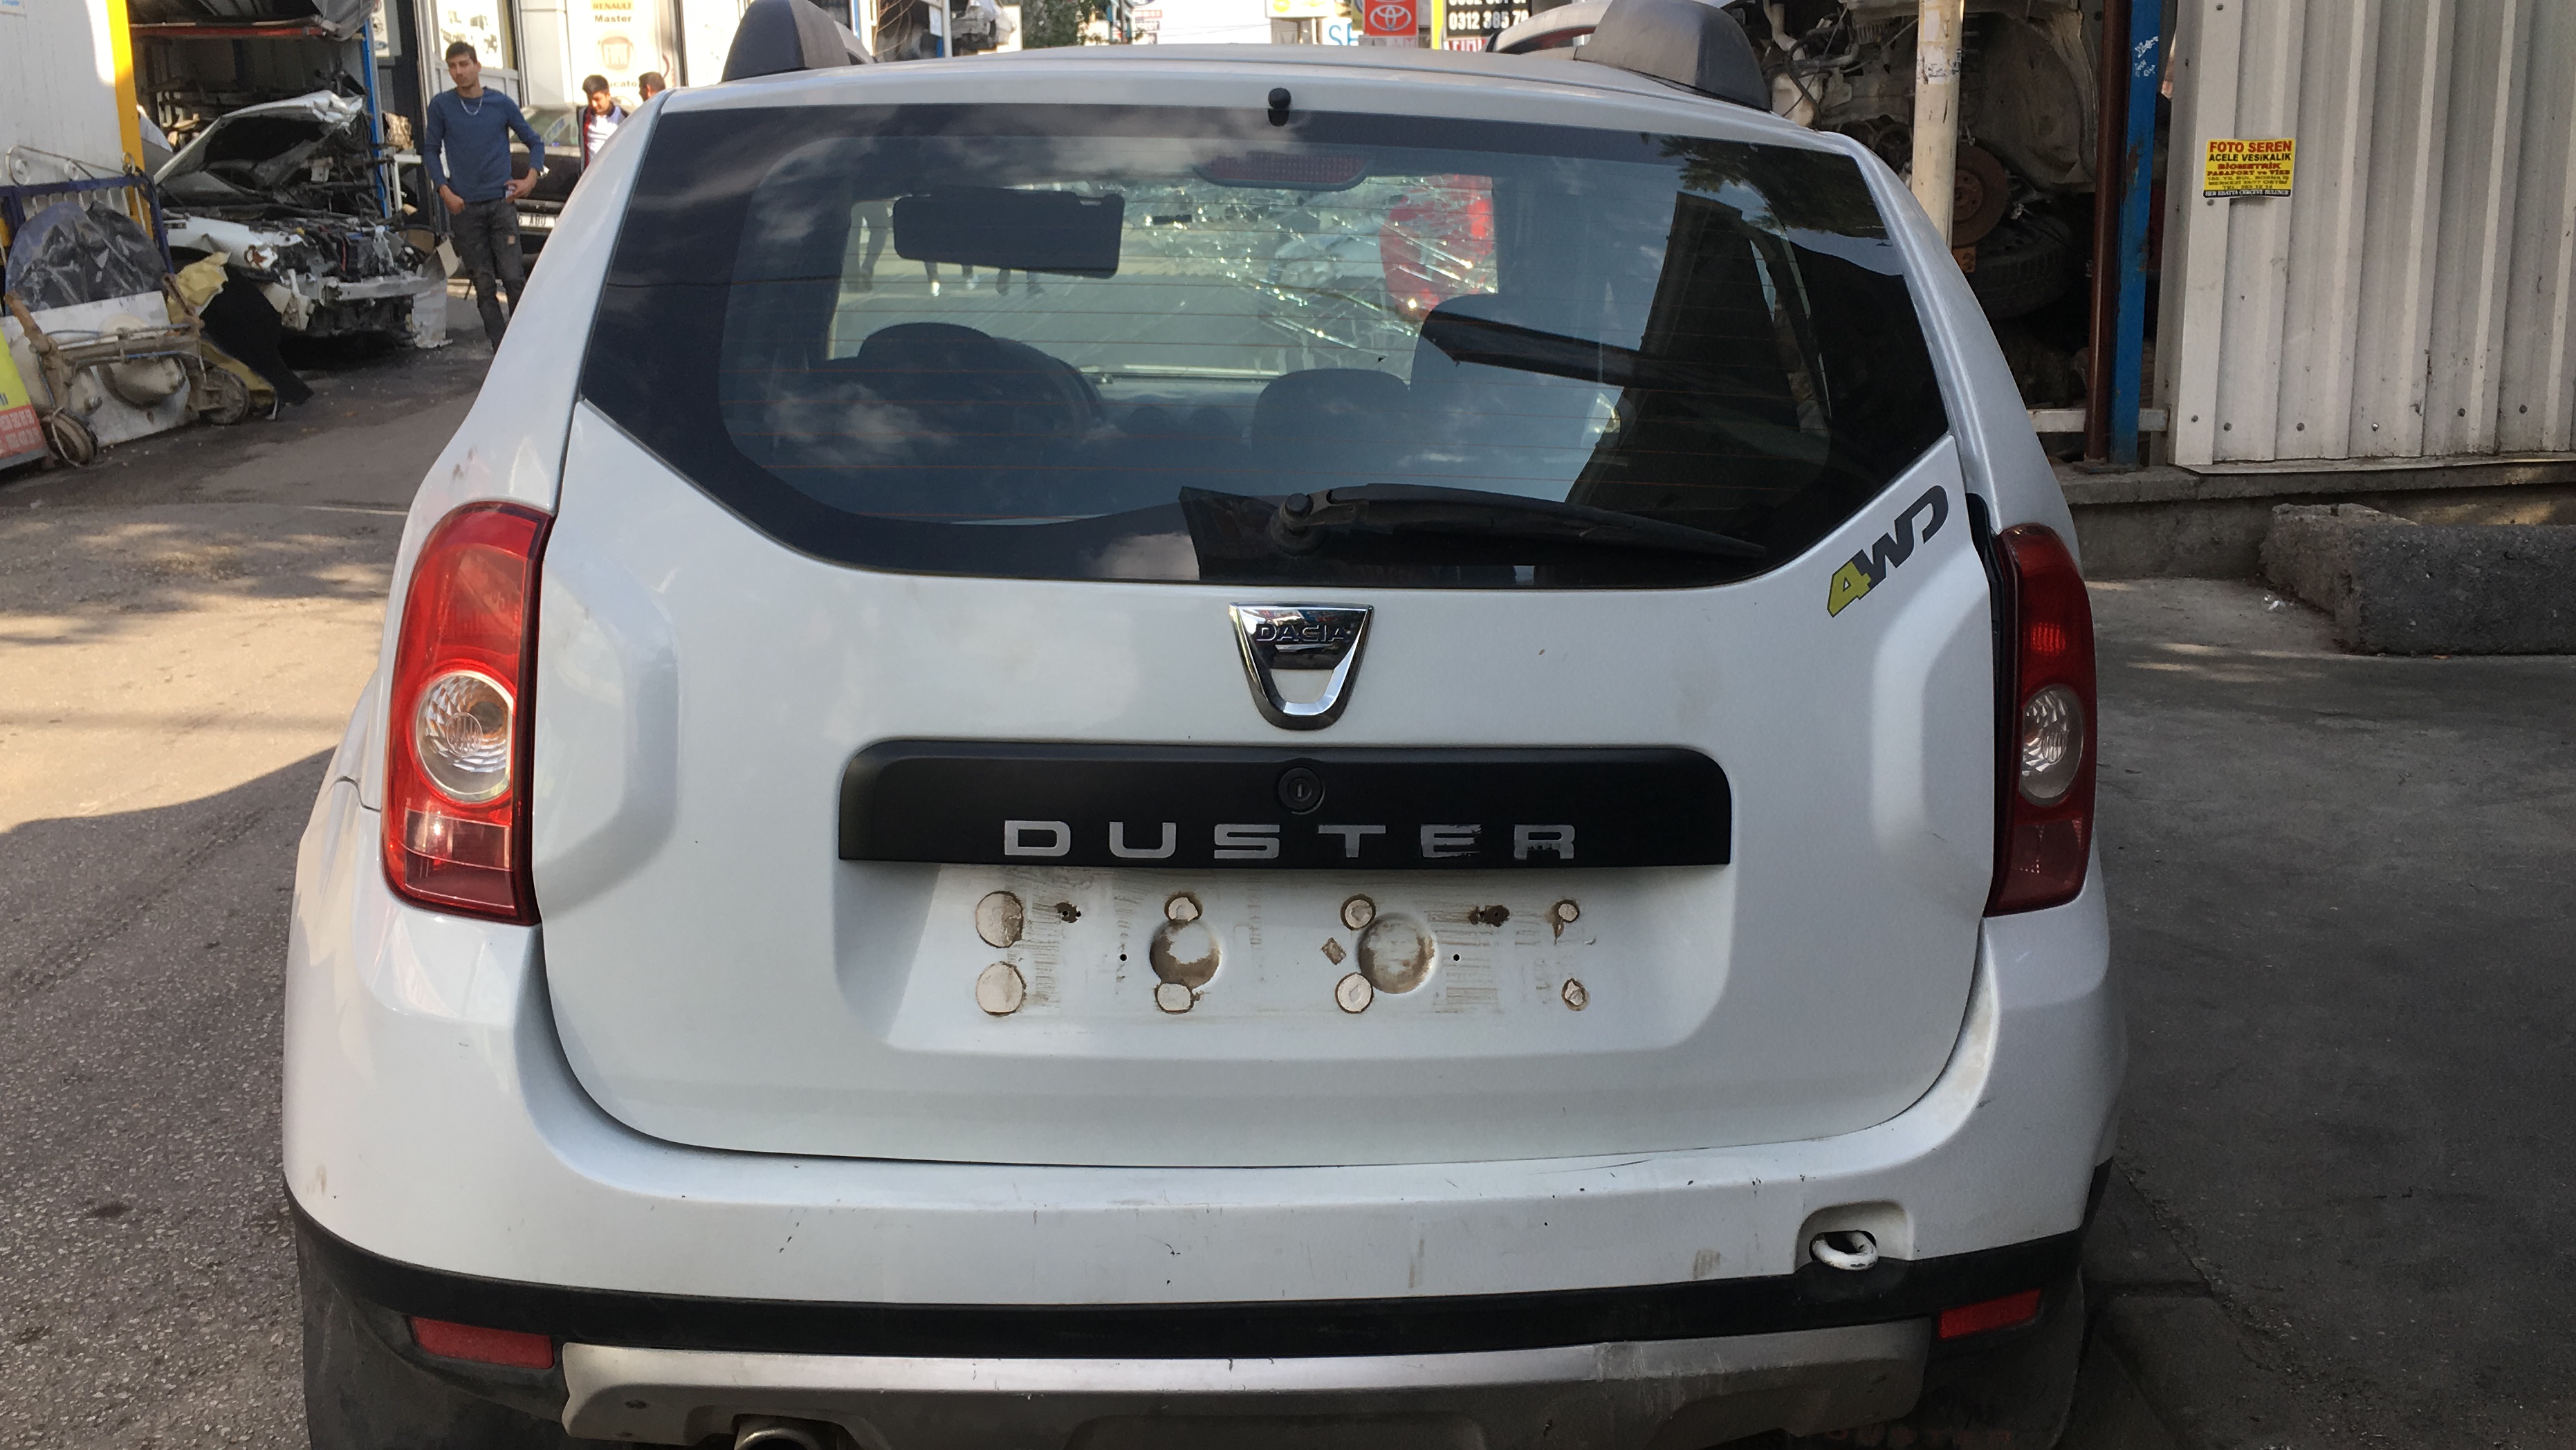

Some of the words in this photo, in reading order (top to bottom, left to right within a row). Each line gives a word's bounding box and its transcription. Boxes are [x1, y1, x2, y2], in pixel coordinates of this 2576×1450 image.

[1448, 10, 1480, 30] 0312
[1483, 9, 1509, 28] 385
[2210, 141, 2244, 152] FOTO
[2248, 140, 2292, 152] SEREN
[1827, 485, 1949, 618] 4WD
[1256, 624, 1349, 642] DACIA
[1004, 820, 1576, 860] DUSTER
